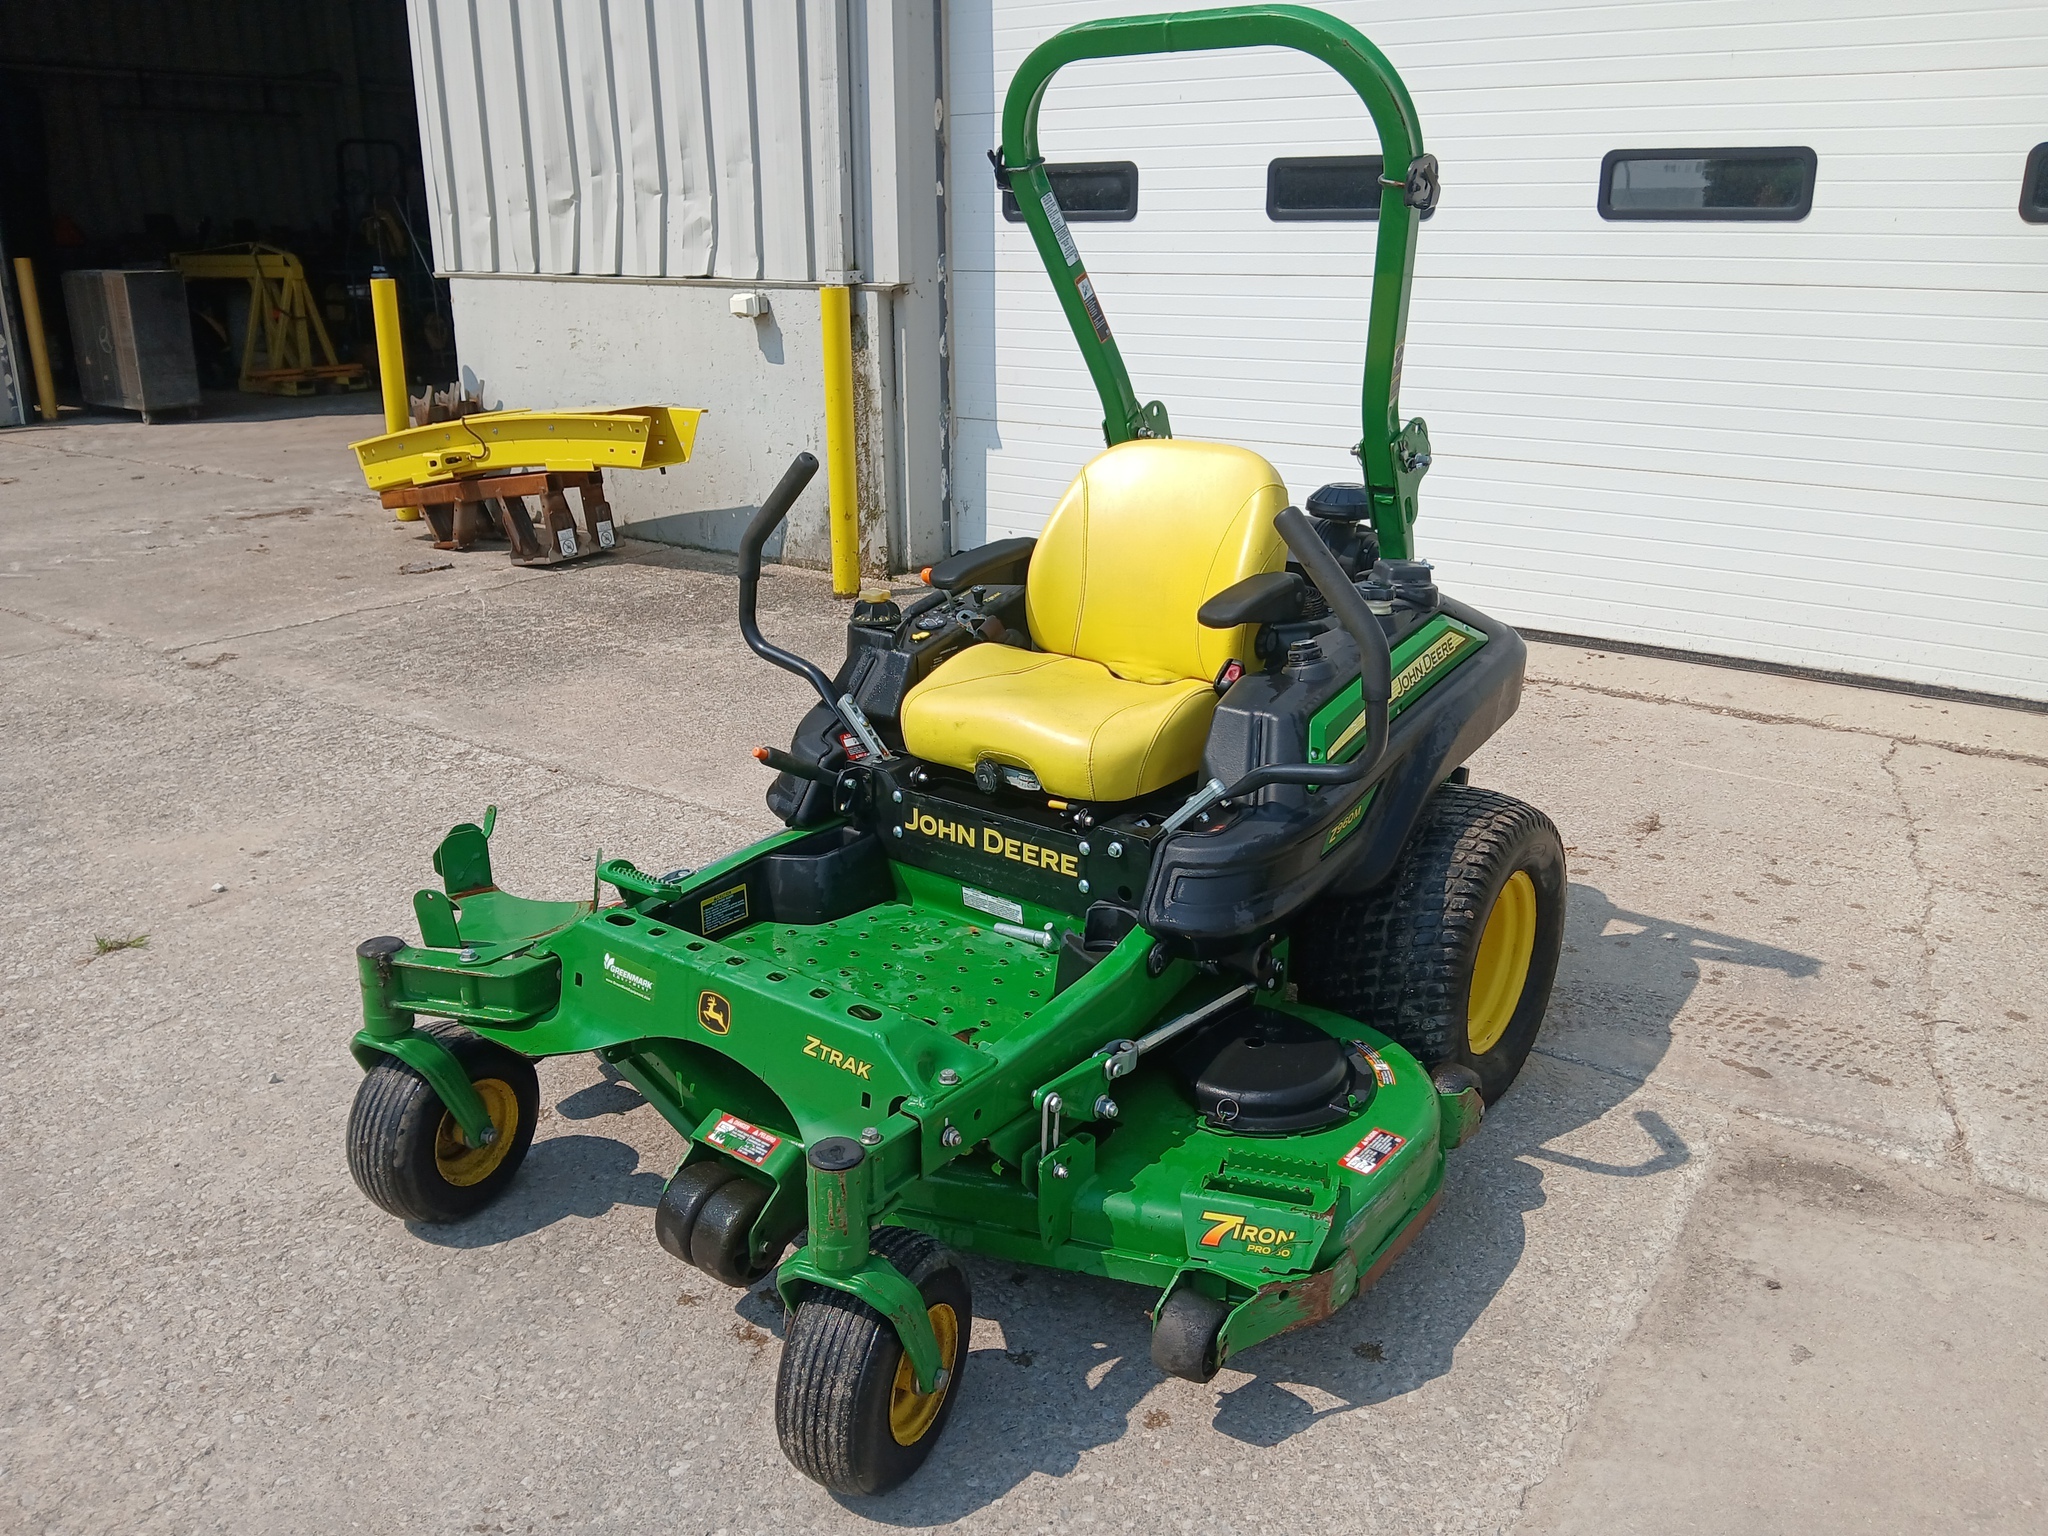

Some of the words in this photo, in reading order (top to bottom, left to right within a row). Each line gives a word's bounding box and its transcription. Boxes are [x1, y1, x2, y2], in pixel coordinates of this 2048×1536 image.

[1397, 662, 1424, 696] JOHN
[1422, 637, 1455, 671] DEERE
[904, 808, 976, 848] JOHN
[983, 827, 1079, 878] DEERE
[1328, 804, 1362, 844] Z960M
[610, 965, 653, 990] GREENMARK
[803, 1034, 873, 1081] ZTRAK
[1246, 1244, 1272, 1255] PRO
